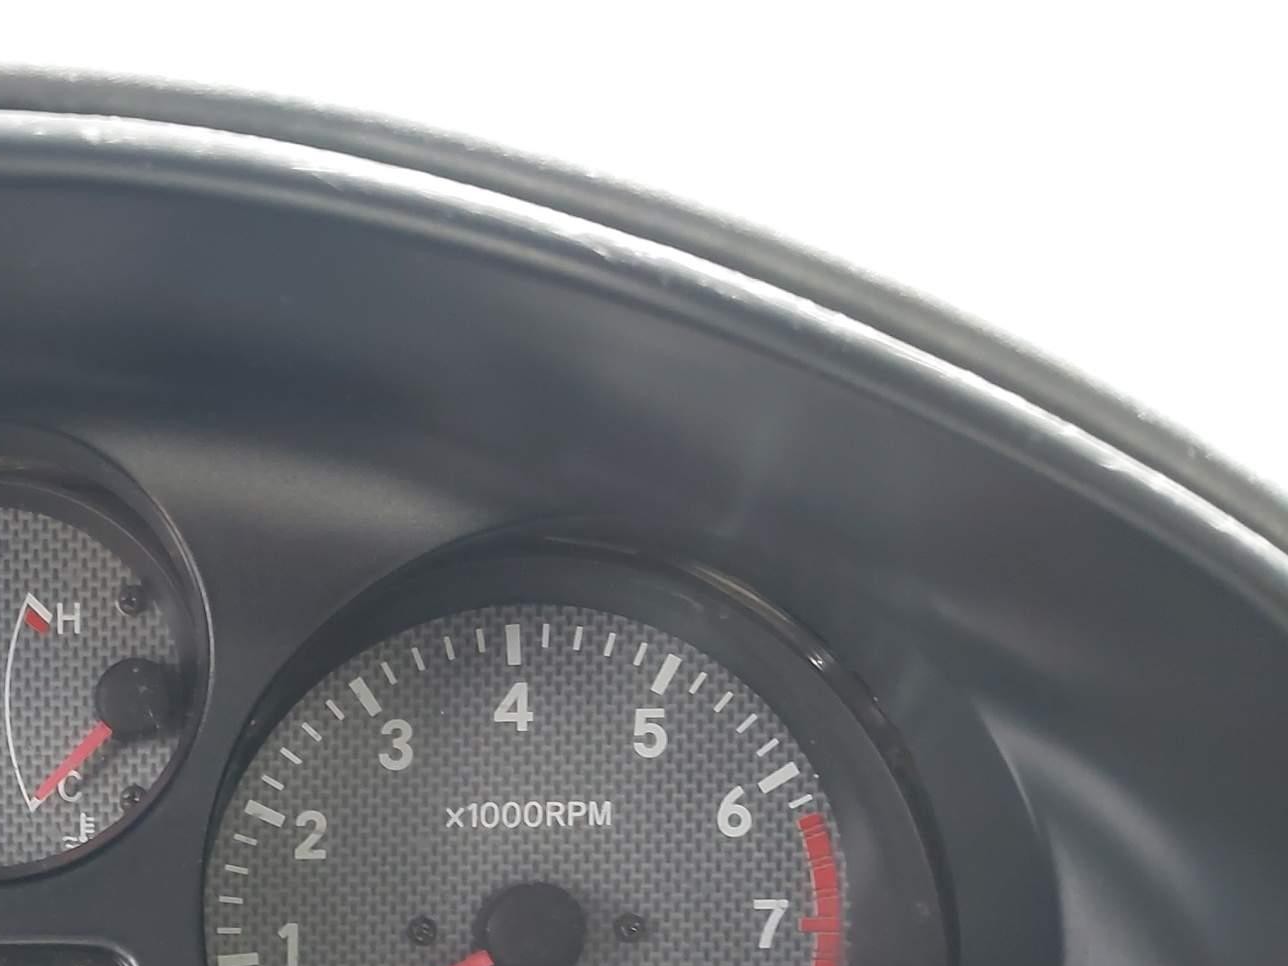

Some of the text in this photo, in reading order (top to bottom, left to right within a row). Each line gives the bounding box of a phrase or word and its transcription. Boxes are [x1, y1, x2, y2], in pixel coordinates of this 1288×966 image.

[56, 602, 81, 634] H
[494, 682, 534, 731] 4
[378, 719, 413, 771] 3
[632, 708, 668, 758] 5
[57, 769, 83, 802] C
[293, 810, 328, 860] 2
[445, 800, 613, 829] x1000RPM
[716, 785, 753, 838] 6
[753, 898, 789, 948] 7
